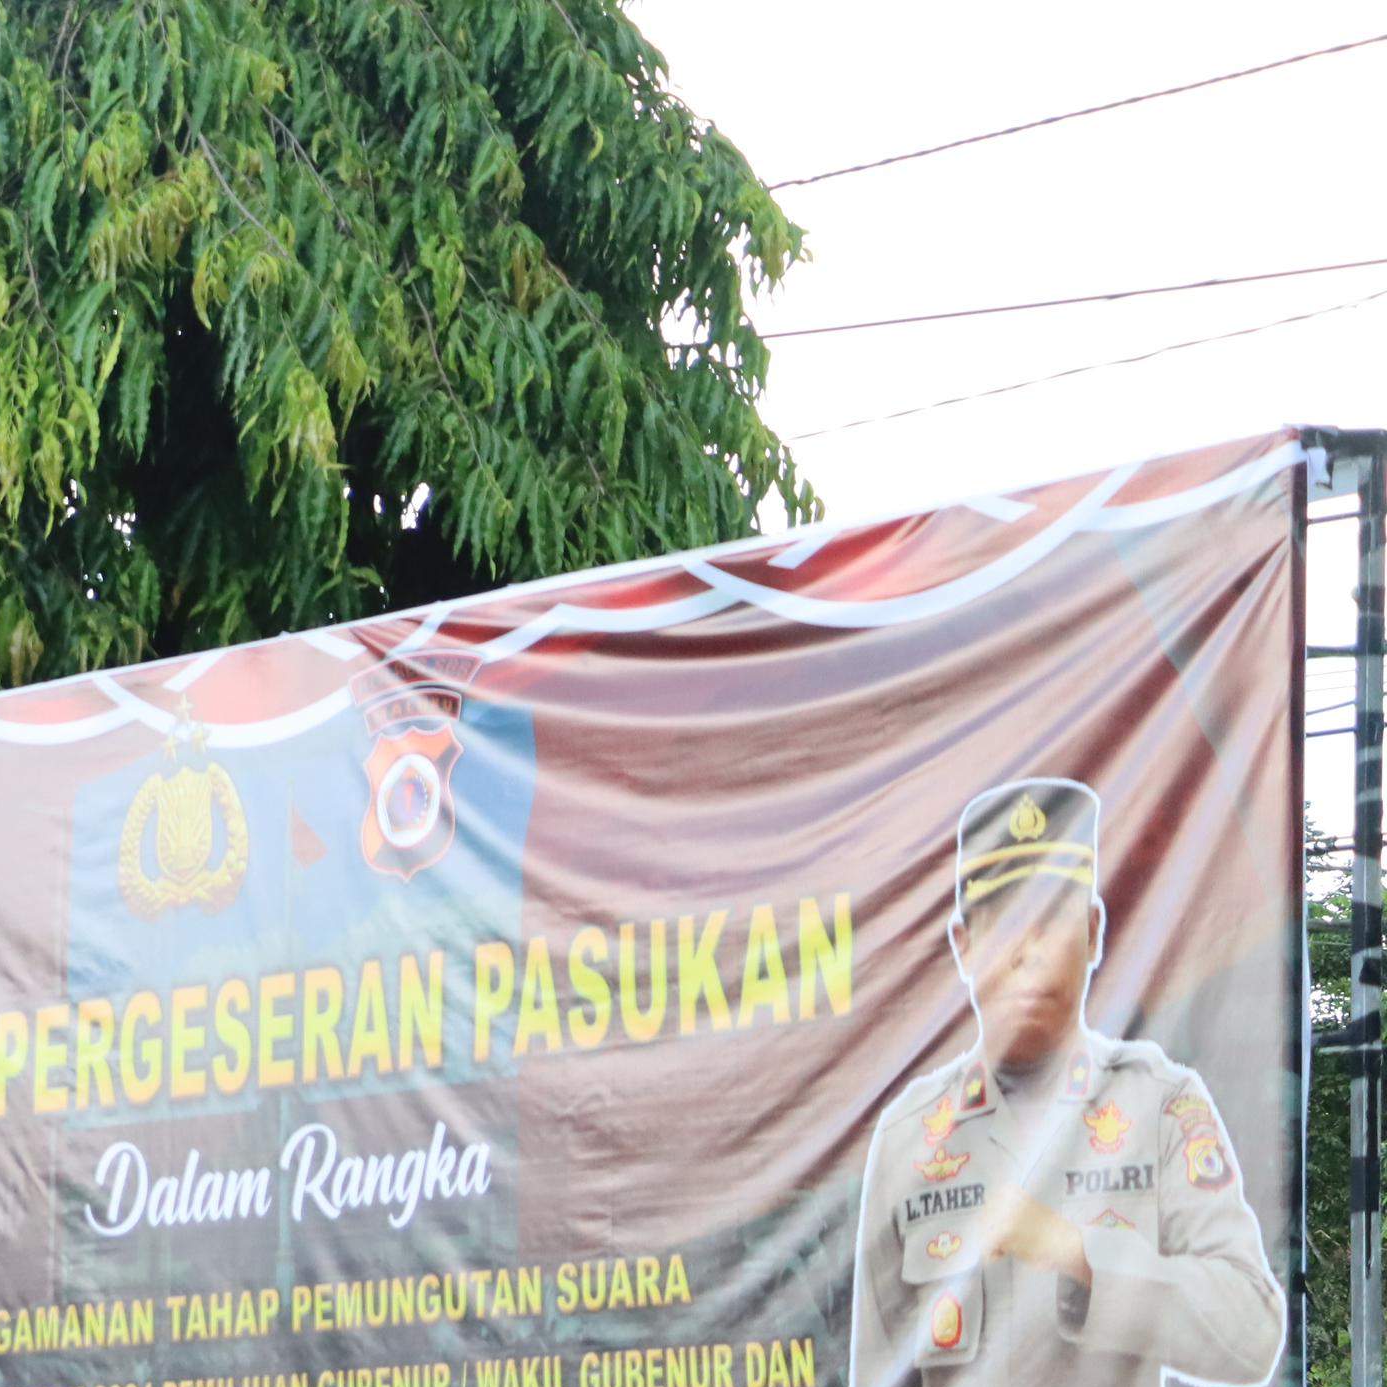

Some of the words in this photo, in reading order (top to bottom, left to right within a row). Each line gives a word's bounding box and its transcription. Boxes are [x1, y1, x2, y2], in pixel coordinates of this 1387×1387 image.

[474, 892, 854, 1060] PASUKAN
[85, 1140, 273, 1238] Dalam
[279, 1119, 493, 1229] Rangka
[1065, 1164, 1154, 1195] POLRI
[167, 1288, 281, 1342] TAHAP
[292, 1265, 542, 1333] PEMUNGUTAN
[556, 1253, 692, 1314] SUARA
